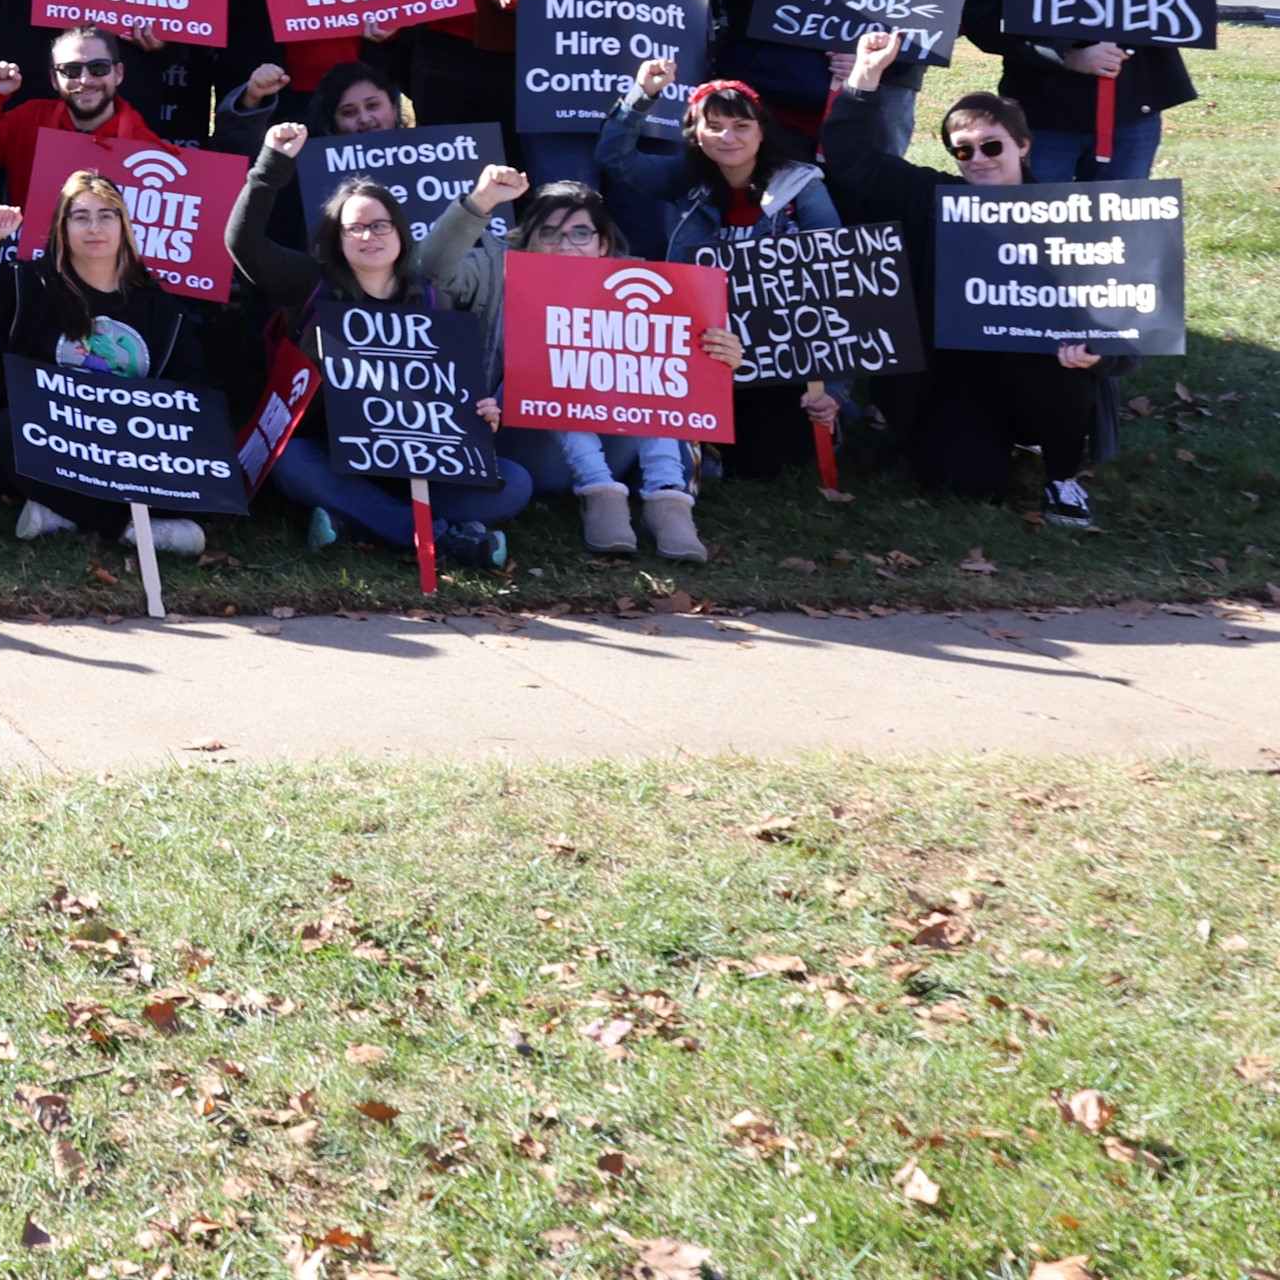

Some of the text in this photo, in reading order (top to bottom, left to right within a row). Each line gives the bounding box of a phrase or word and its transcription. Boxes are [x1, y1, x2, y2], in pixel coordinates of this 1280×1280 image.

[774, 4, 944, 60] SECUTY
[943, 193, 1179, 224] Microsoft Runs
[696, 226, 902, 272] OUTSOURCING
[999, 236, 1125, 265] on Trust
[725, 256, 899, 307] HREATENS
[966, 278, 1157, 314] Outsourcing
[343, 308, 439, 350] OUR
[546, 304, 691, 356] REMOTE
[769, 305, 851, 343] JOB
[983, 326, 1140, 340] ULP Strike Against Microsoft
[36, 368, 200, 414] Microsoft
[325, 356, 469, 403] UNION,
[549, 345, 690, 398] WORKS
[49, 401, 193, 441] Hire Our
[363, 397, 466, 435] OUR
[22, 420, 231, 478] Contractors
[339, 435, 487, 477] JOBS!!
